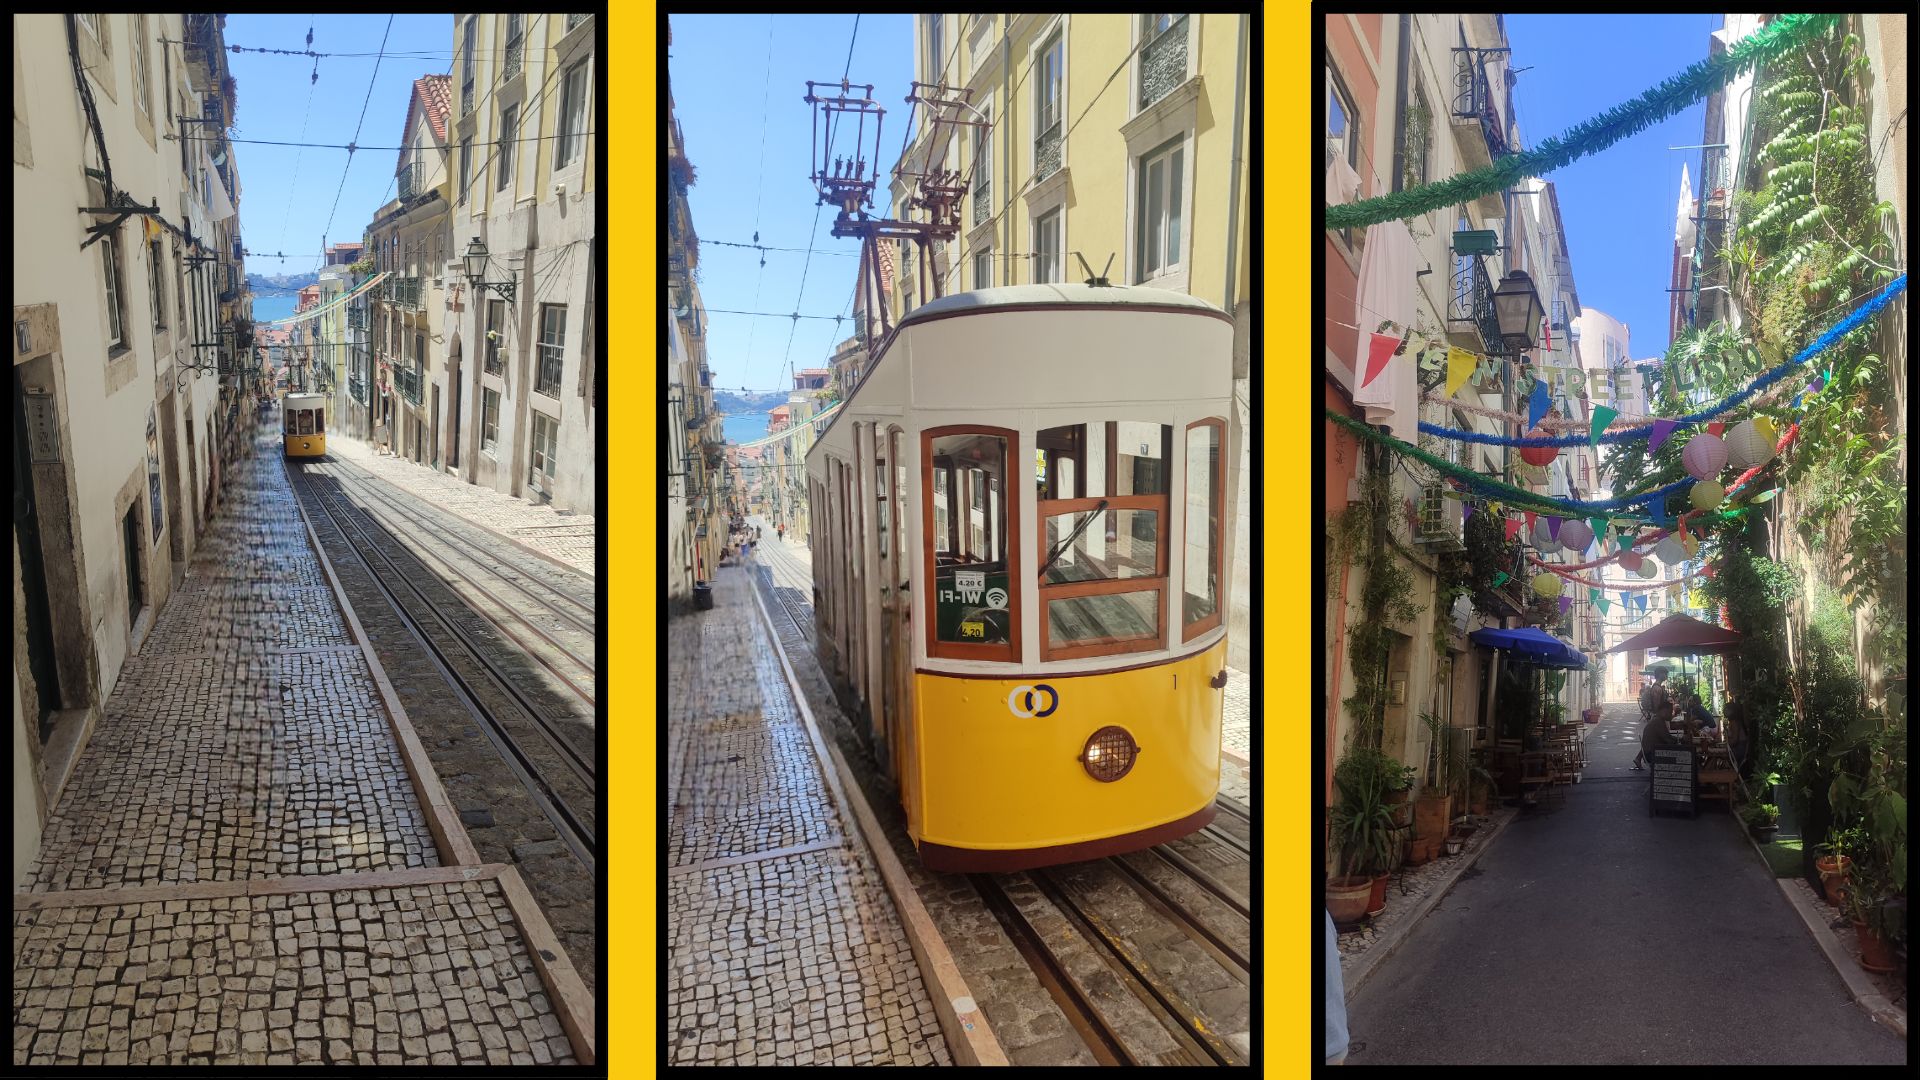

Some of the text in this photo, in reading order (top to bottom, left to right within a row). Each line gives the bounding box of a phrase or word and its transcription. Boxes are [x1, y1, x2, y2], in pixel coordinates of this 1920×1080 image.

[1515, 362, 1652, 400] STREET
[1669, 333, 1786, 393] LISBON
[962, 629, 980, 637] 4.20
